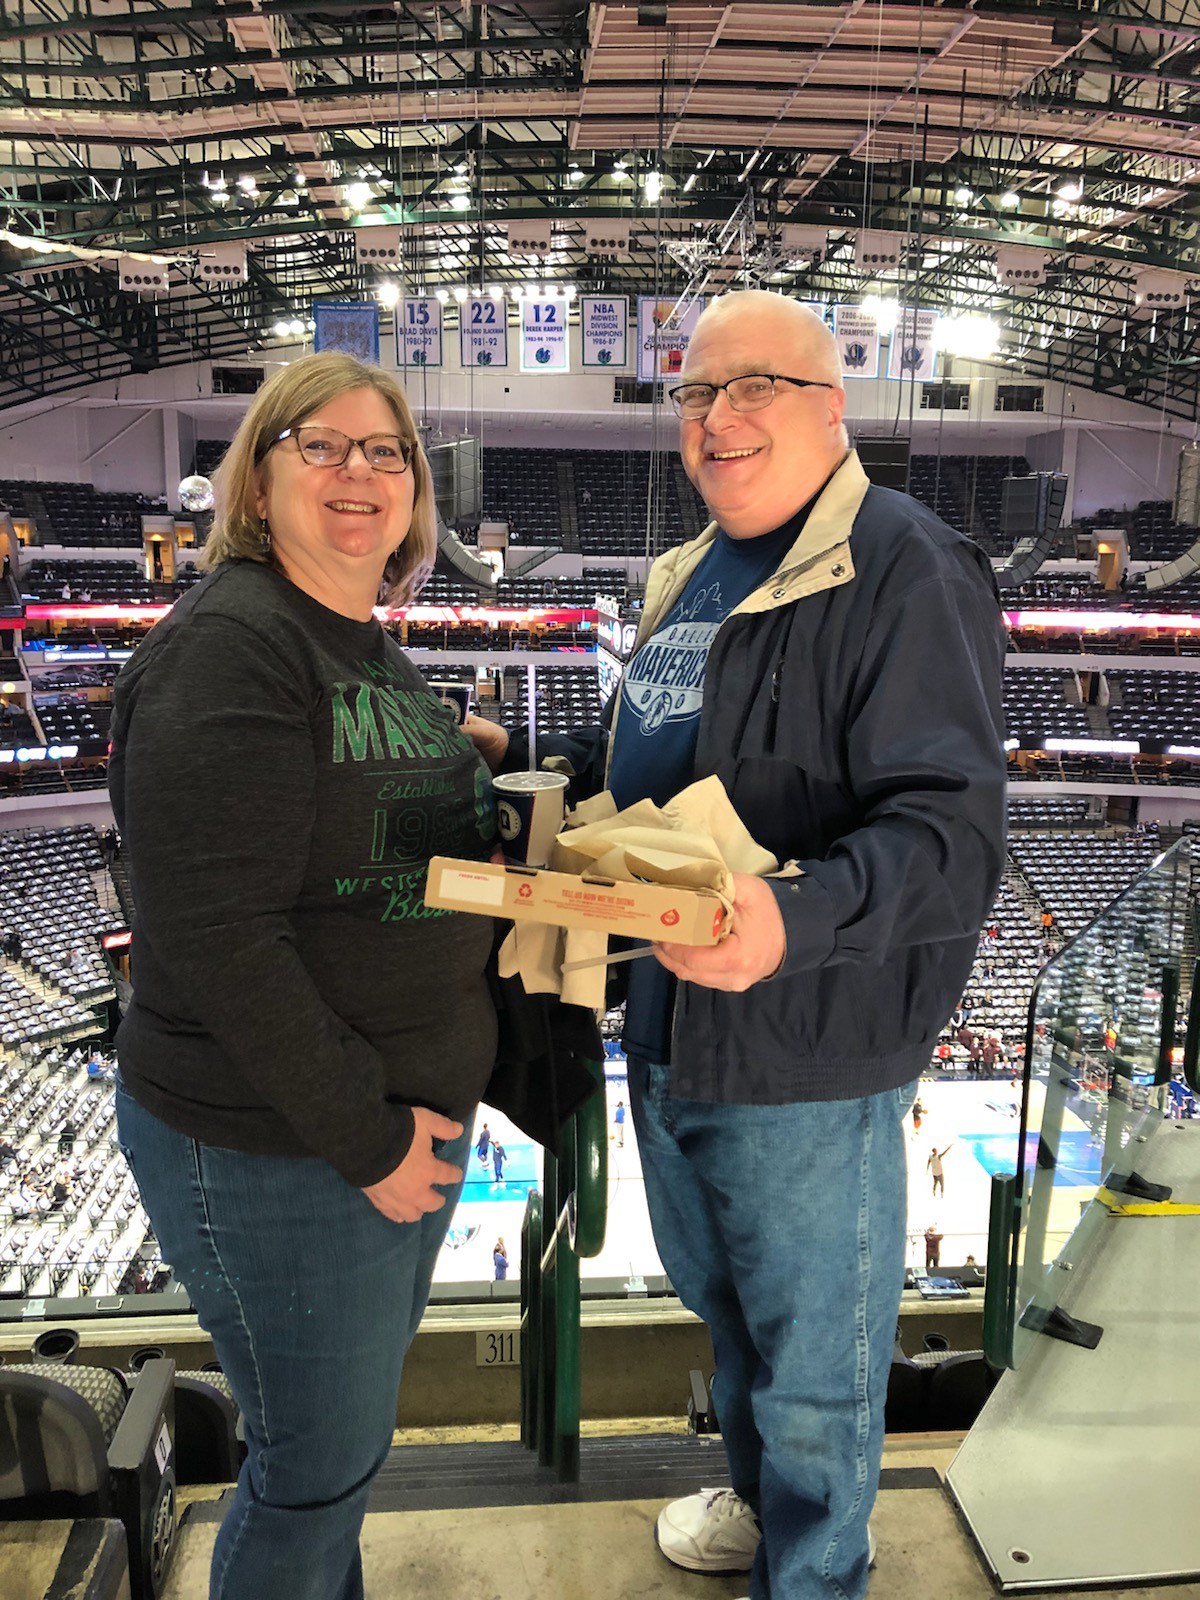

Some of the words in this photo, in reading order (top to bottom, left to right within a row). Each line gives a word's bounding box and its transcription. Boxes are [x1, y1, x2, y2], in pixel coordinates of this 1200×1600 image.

[407, 303, 430, 325] 15
[471, 302, 496, 324] 22
[533, 304, 556, 323] 12
[593, 303, 615, 314] NBA
[399, 327, 418, 336] BRAD
[419, 327, 438, 336] DAVIS
[591, 322, 618, 330] DIVISION
[840, 328, 874, 337] CHAMPIONS
[586, 330, 623, 338] CHAMPIONS
[628, 648, 708, 688] MAVERIC
[485, 1333, 516, 1364] 311
